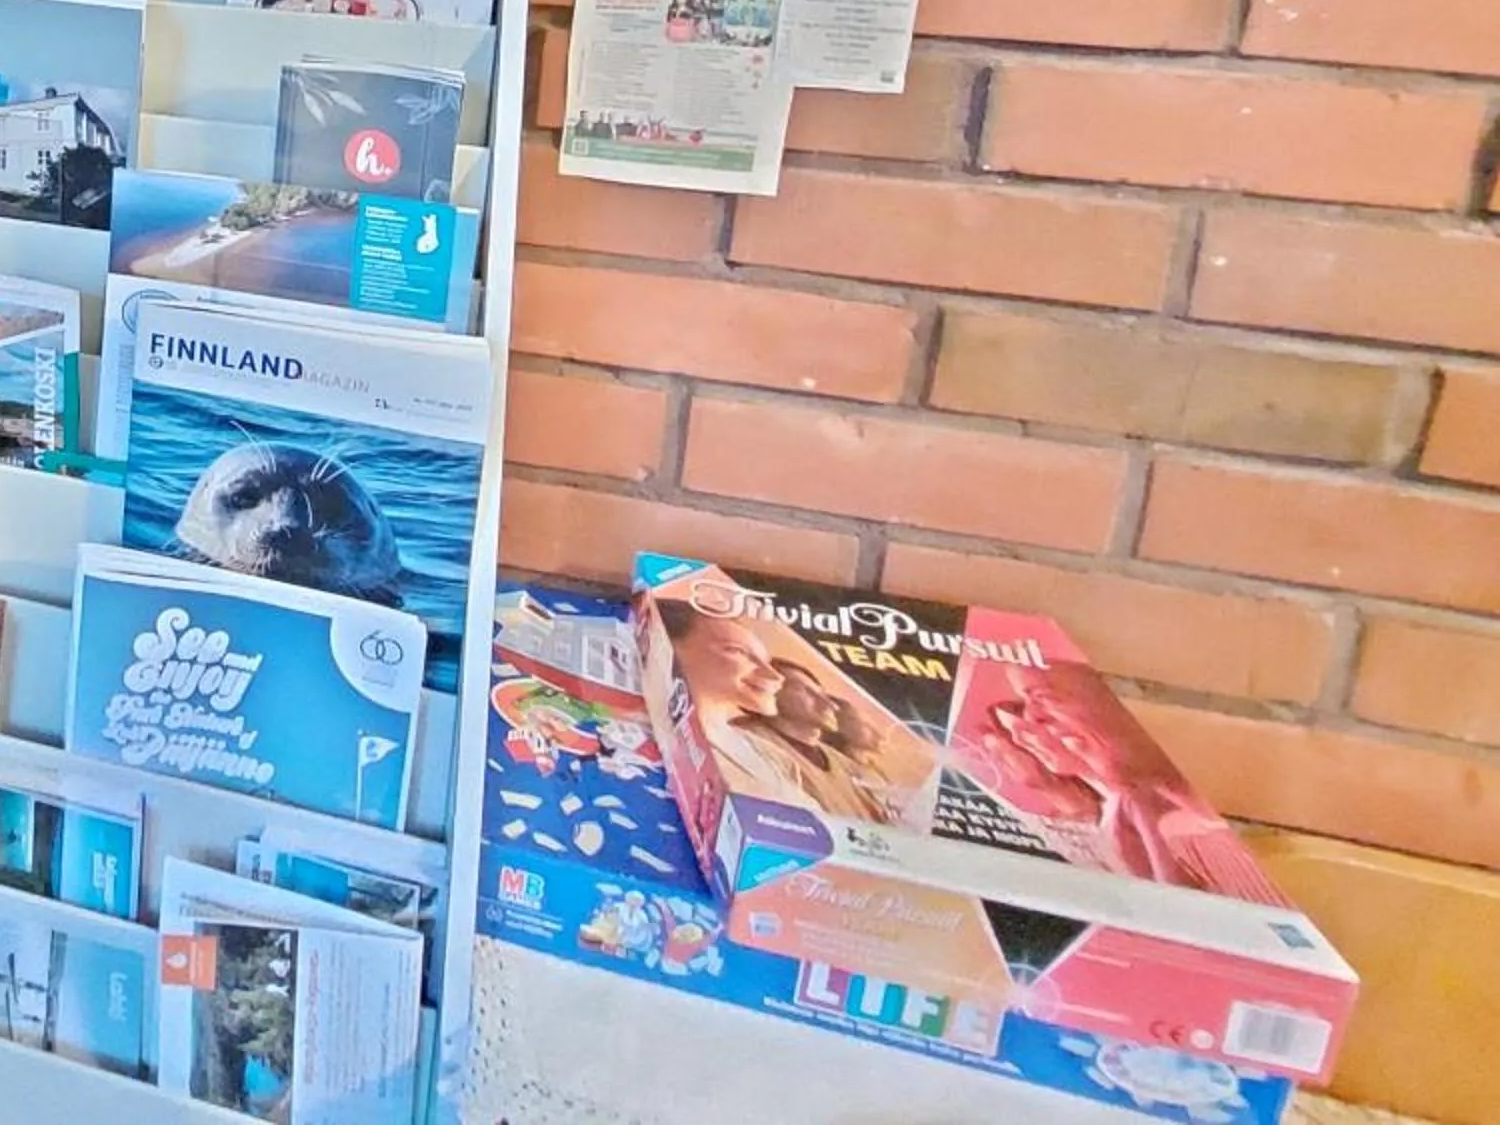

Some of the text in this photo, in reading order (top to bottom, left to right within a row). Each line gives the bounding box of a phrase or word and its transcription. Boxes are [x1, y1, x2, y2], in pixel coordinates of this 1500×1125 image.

[150, 332, 303, 381] FINNLAND
[133, 607, 230, 663] See
[690, 578, 1051, 671] Trivial Pursuit
[123, 658, 252, 712] Enjoy
[818, 639, 953, 682] TEAM
[499, 866, 546, 898] MB
